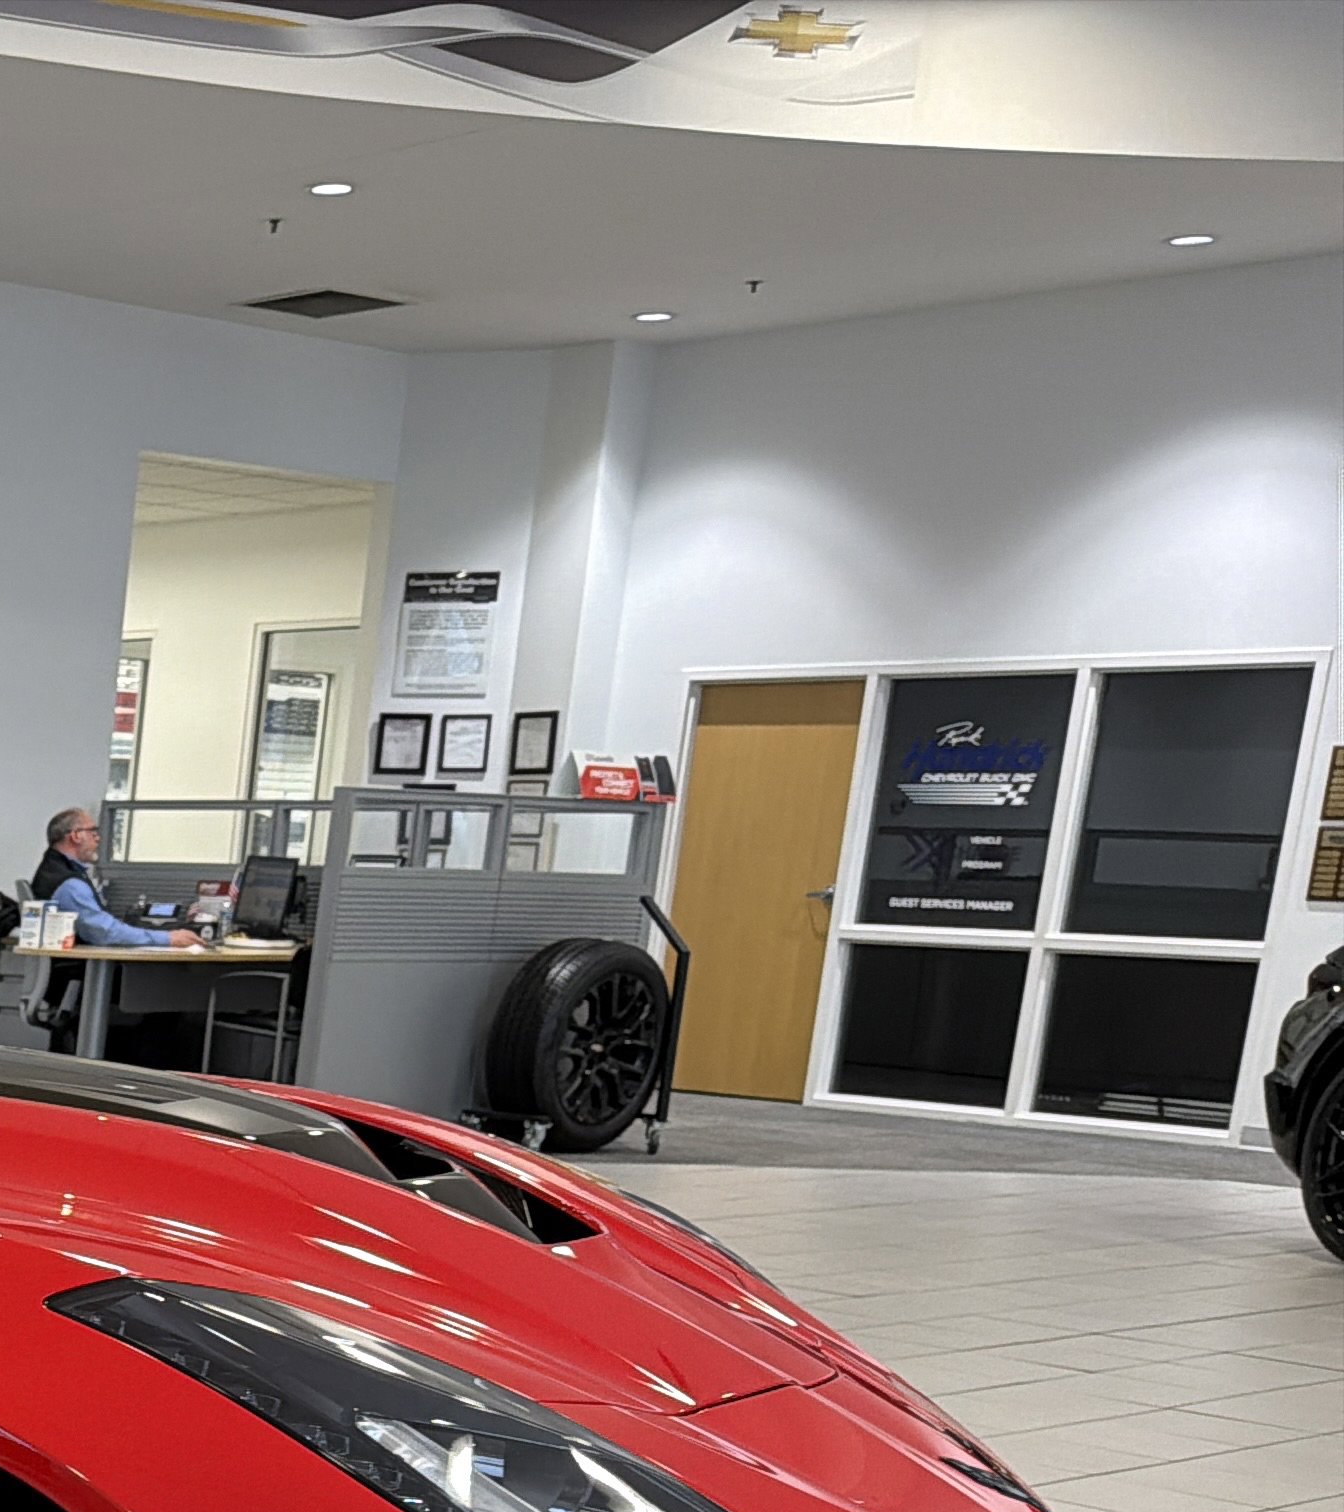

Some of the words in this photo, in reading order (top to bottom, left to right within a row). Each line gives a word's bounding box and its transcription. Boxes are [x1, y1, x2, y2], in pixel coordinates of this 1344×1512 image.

[920, 772, 979, 783] CHEVROLET
[979, 772, 1011, 783] BUICK
[888, 896, 920, 908] GUEST
[920, 898, 965, 910] SERVICES
[966, 900, 1014, 912] MANAGER
